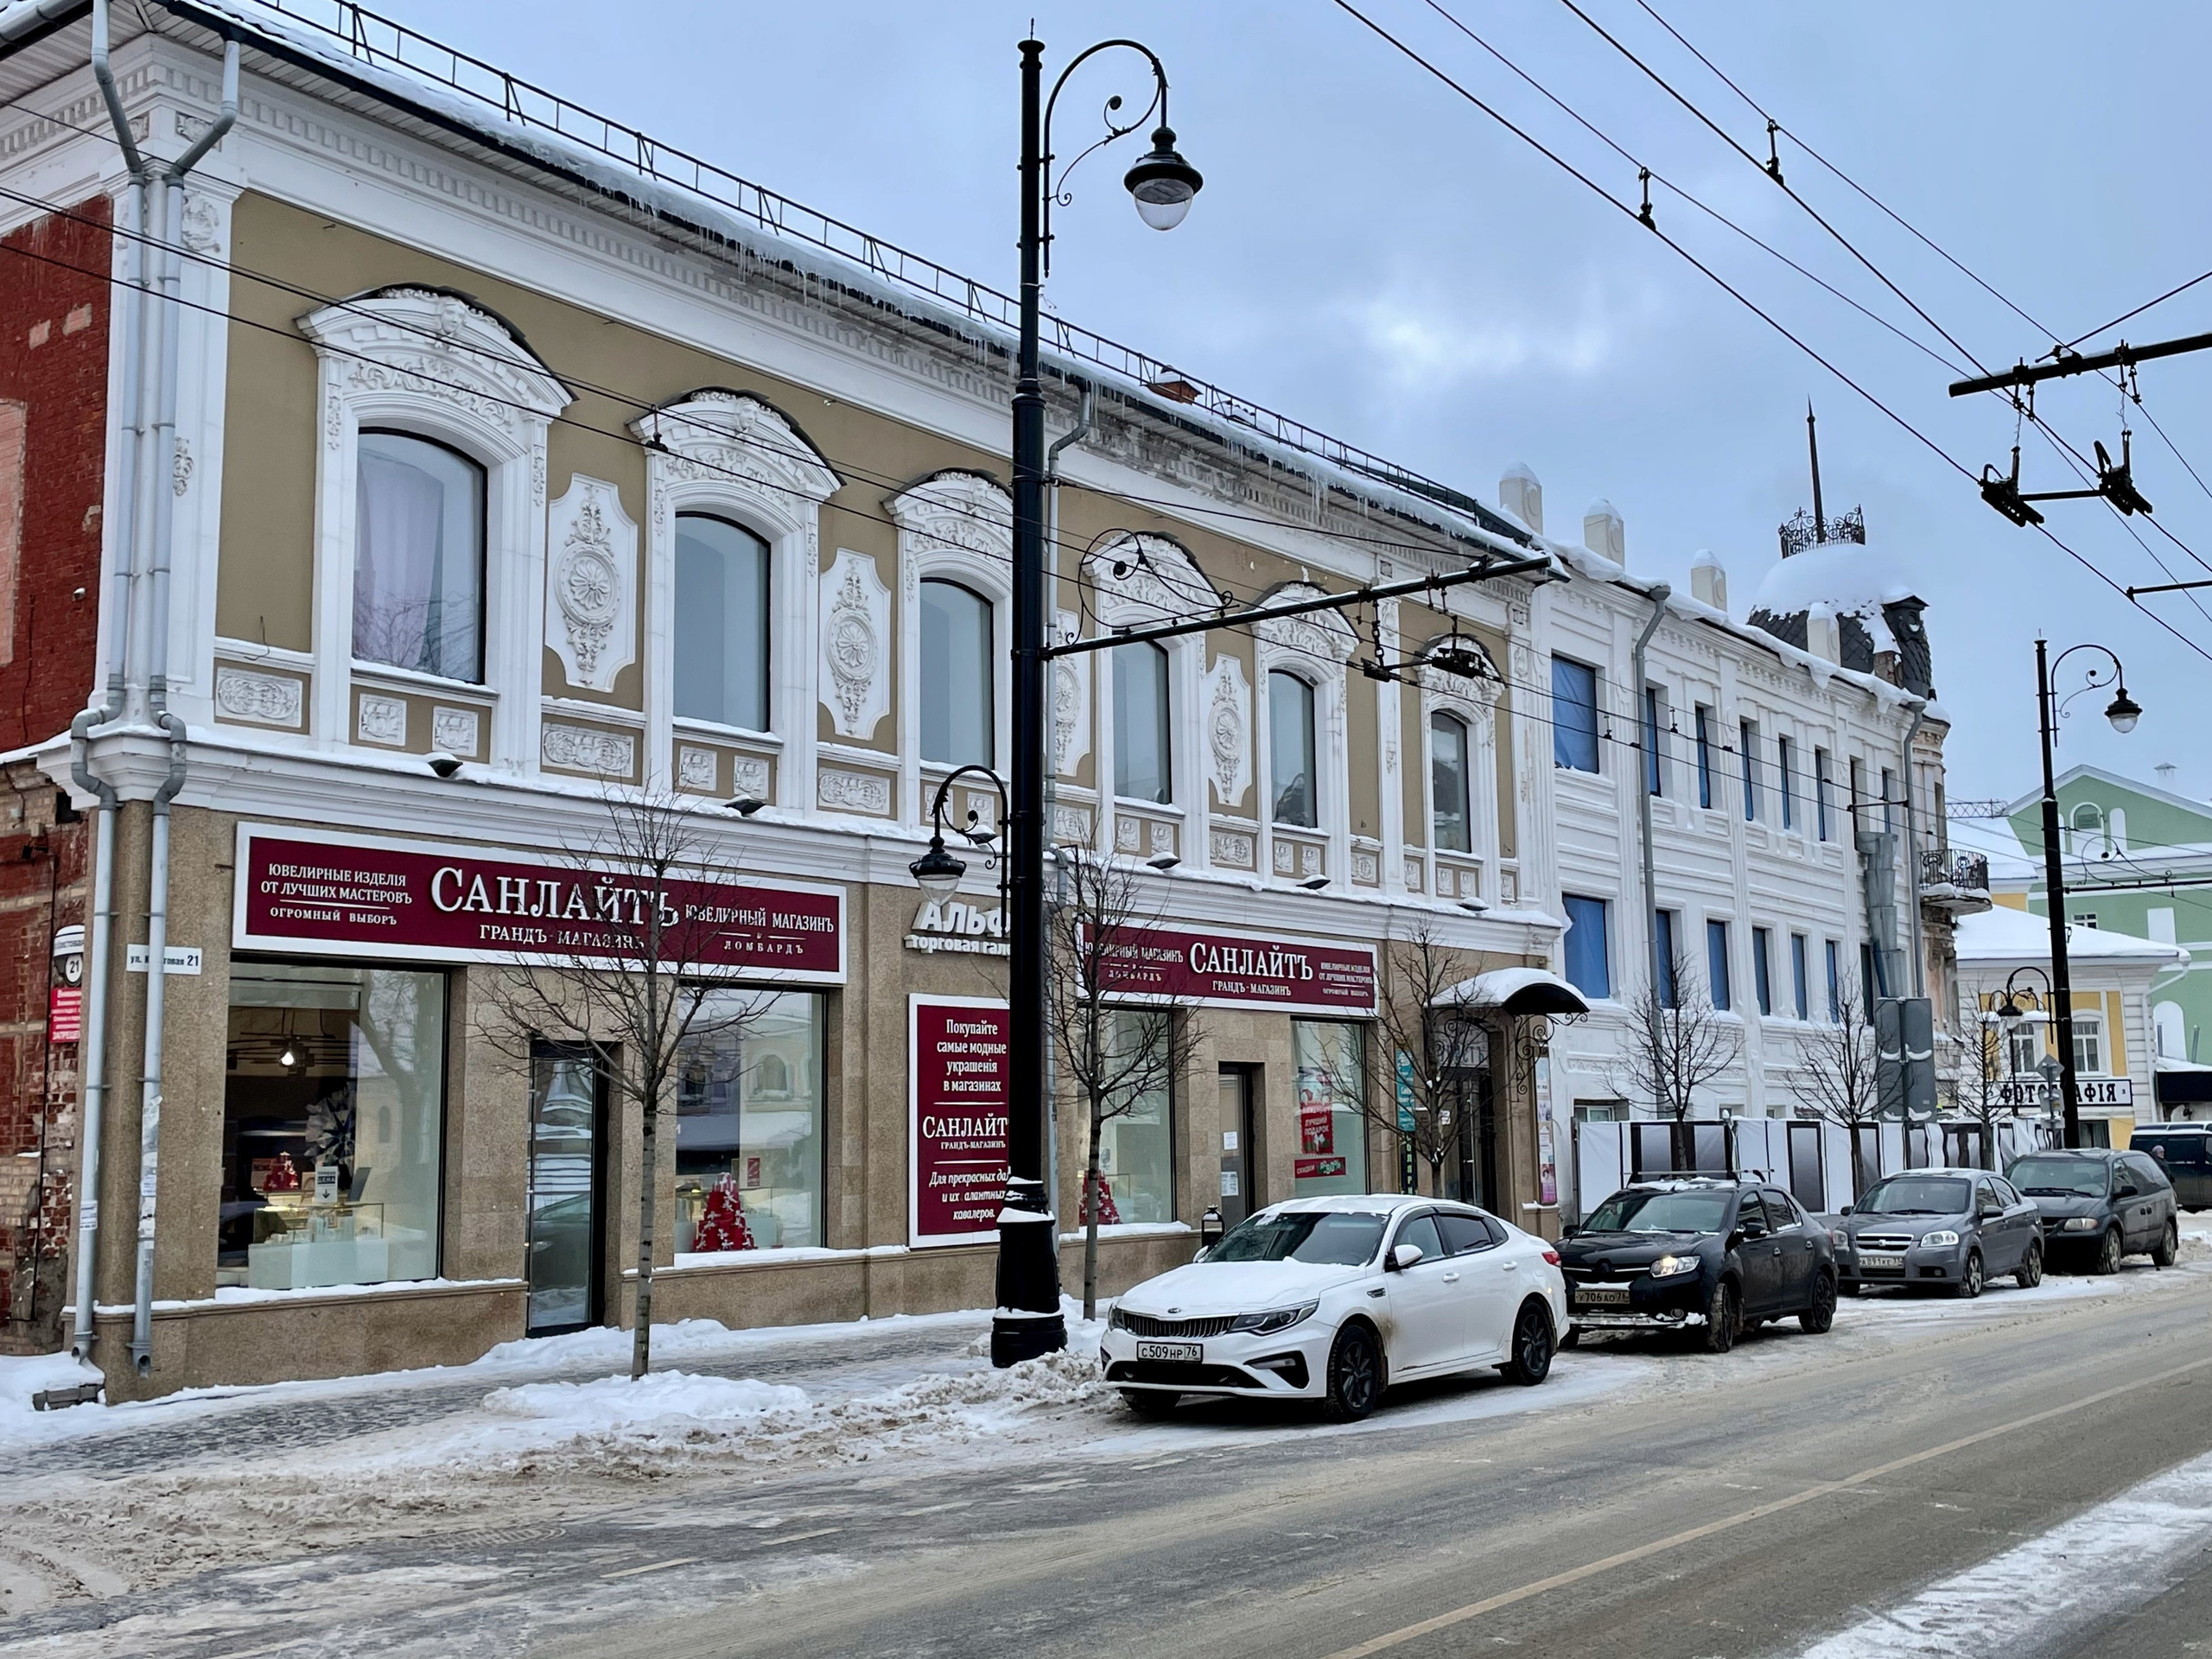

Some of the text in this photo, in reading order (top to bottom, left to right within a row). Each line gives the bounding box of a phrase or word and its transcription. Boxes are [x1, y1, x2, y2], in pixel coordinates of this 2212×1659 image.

[268, 862, 406, 887] ЮВЕЛИРНЫЕ ИЗДЕЛІЯ
[260, 880, 413, 905] ОТ ЛУЧШИХ МАСТЕРОВЪ
[430, 866, 680, 927] САНЛАЙТЪ
[270, 906, 397, 925] ОГРОМНЫЙ ВЫБОРЪ
[685, 904, 835, 933] ЮВЕЛИРНЫЙ МАГАЗИНЪ
[914, 900, 1011, 938] АЛЬФ
[723, 940, 804, 956] ЛОМБАРДЪ
[906, 934, 1011, 956] торговая гале
[69, 959, 80, 974] 21
[144, 954, 185, 966] Ктовая
[187, 954, 200, 967] 21
[1189, 942, 1313, 982] САНЛАЙТЪ
[945, 1019, 999, 1038] Покупайте
[937, 1041, 1007, 1057] самые модные
[945, 1058, 998, 1077] украшенія
[943, 1080, 1001, 1092] в магазинах
[2000, 1083, 2117, 1103] ФОТАФІЯ
[922, 1112, 1009, 1139] САНЛАЙТ
[928, 1167, 1009, 1188] Для прекрасных да
[941, 1193, 948, 1203] и
[949, 1192, 960, 1202] их
